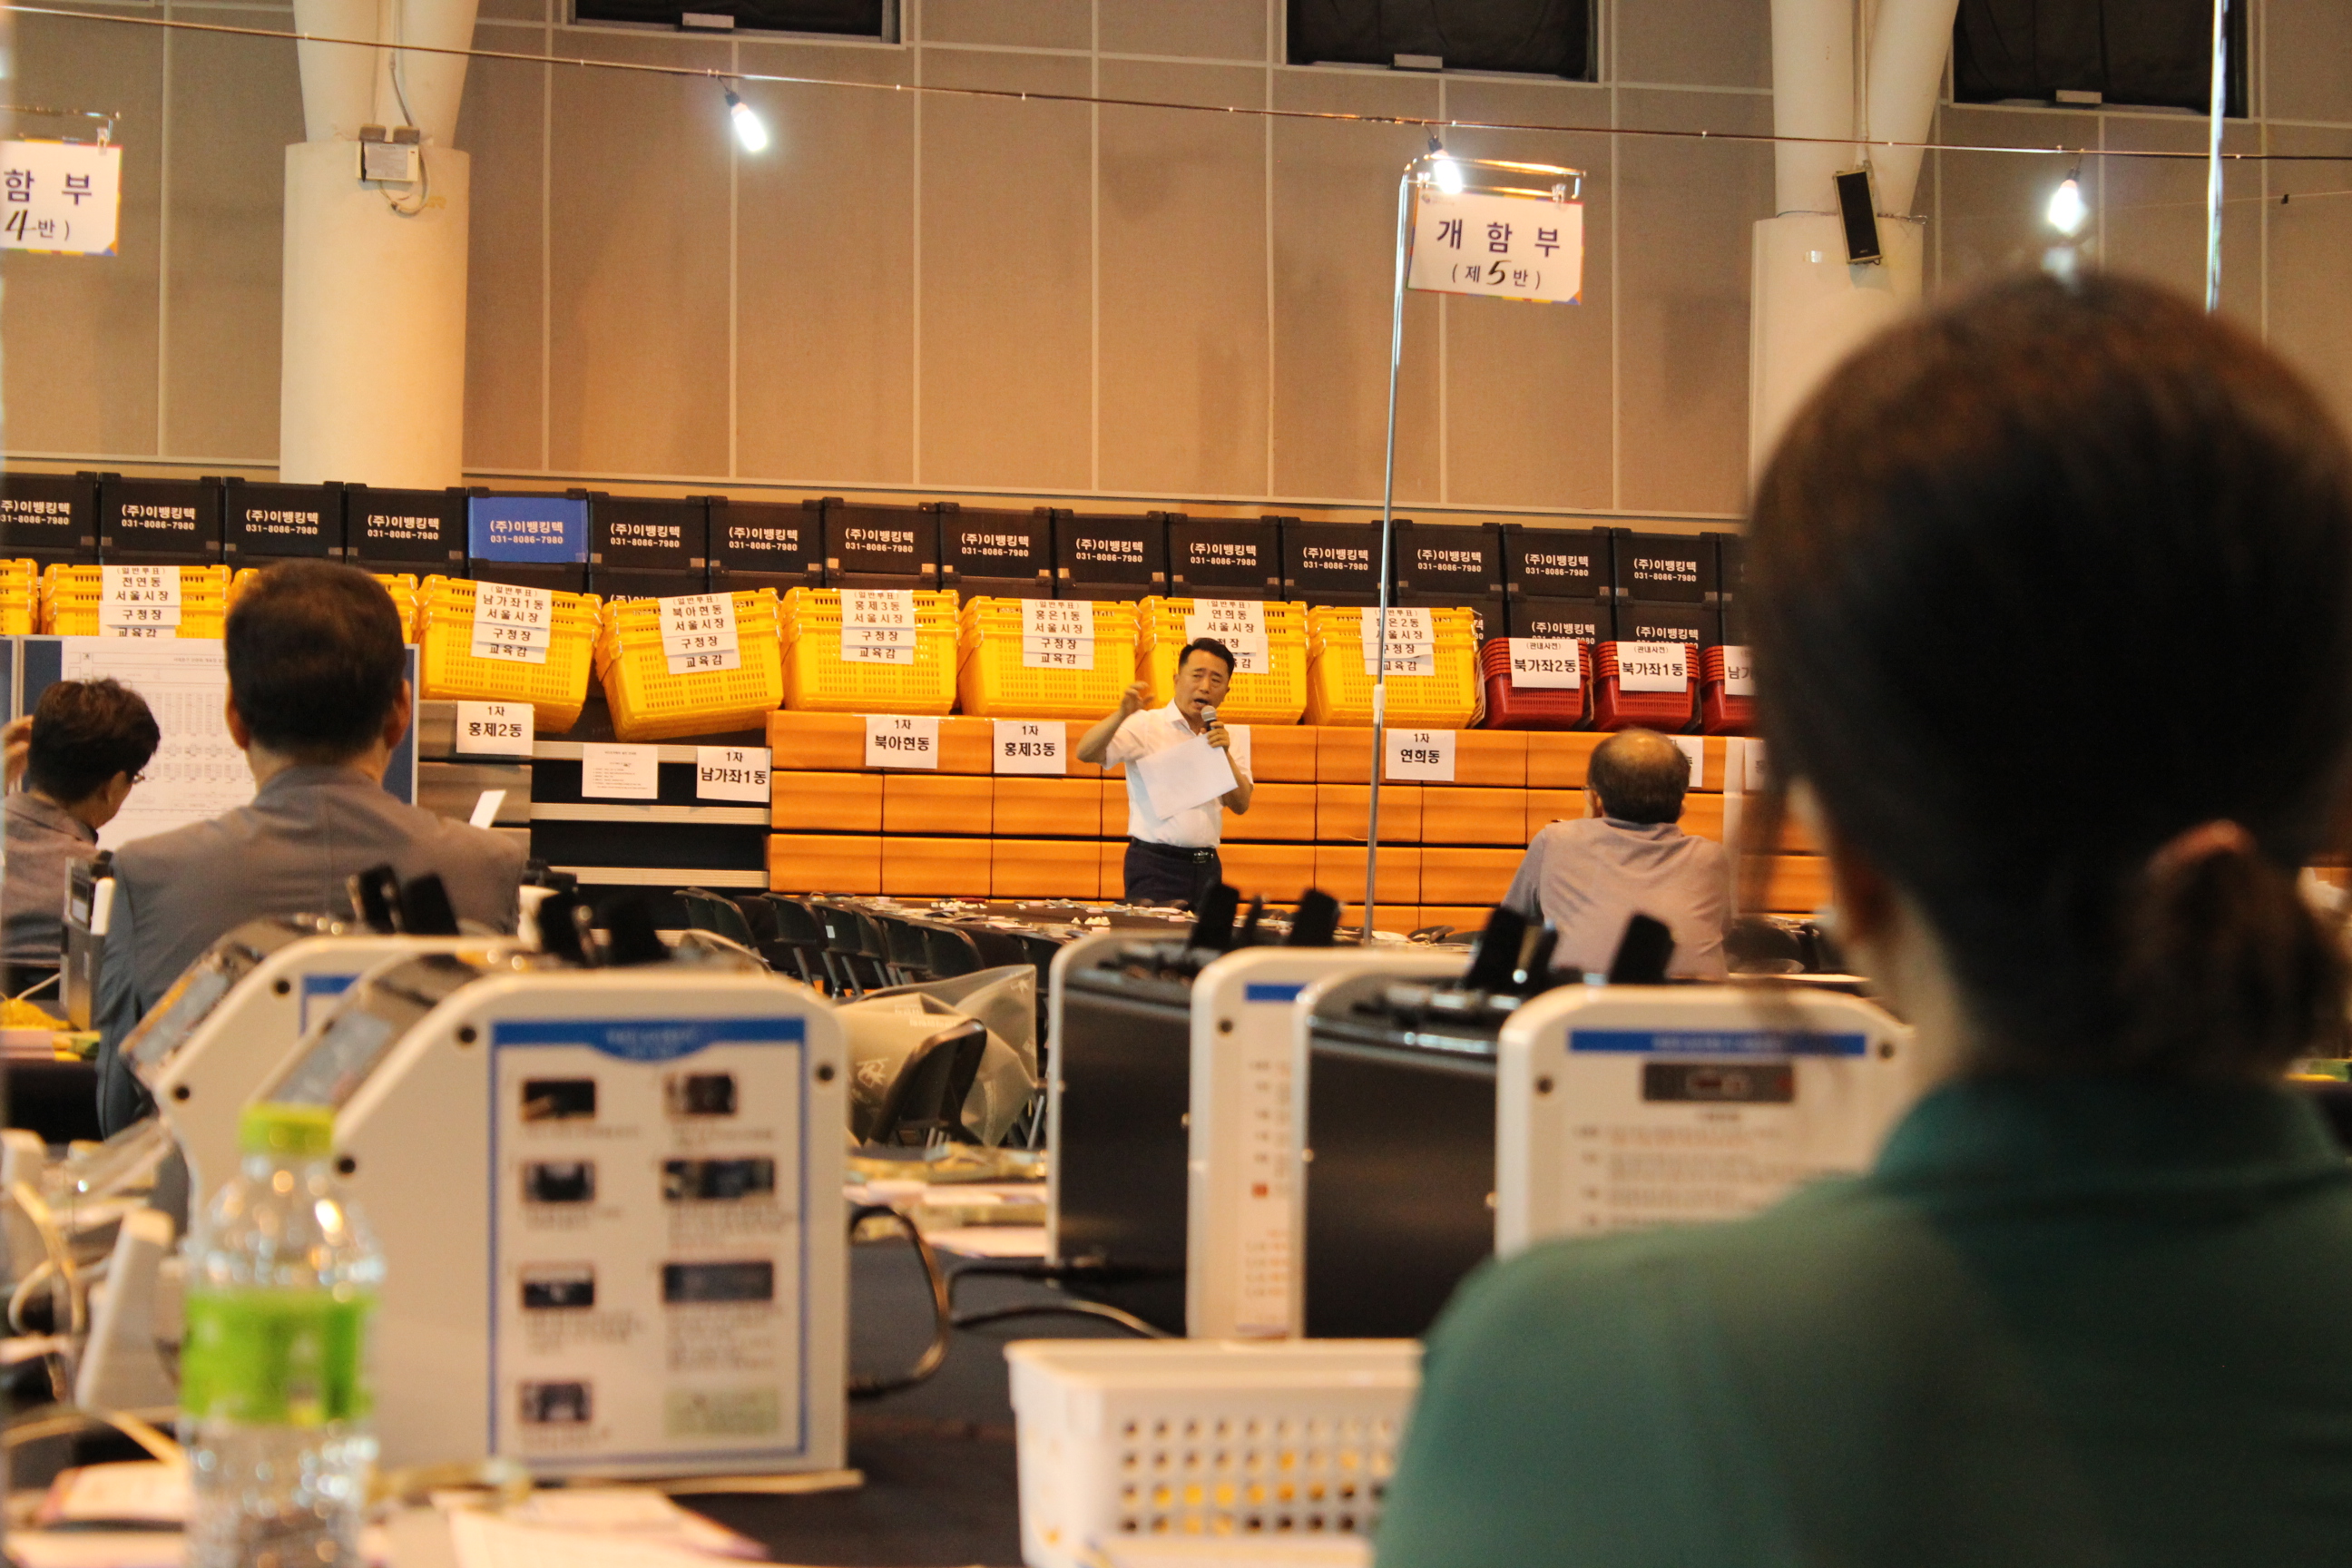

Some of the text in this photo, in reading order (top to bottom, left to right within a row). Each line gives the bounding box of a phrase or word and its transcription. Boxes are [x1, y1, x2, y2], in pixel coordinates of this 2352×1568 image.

[121, 519, 195, 530] 031-8086-7980
[245, 524, 318, 535] 031-8086-7980
[368, 530, 439, 540] 031-8086-7980
[490, 534, 564, 544] 031-8086-7980
[610, 537, 680, 547] 031-8086-7980
[729, 541, 798, 552] 031-8086-7980
[845, 542, 913, 553] 031-8086-7980
[961, 547, 1029, 557] 031-8086-7980
[1075, 553, 1142, 563] 031-8086-7980
[1190, 556, 1257, 566] 031-8086-7980
[1303, 561, 1368, 571] 031-8086-7980
[1417, 563, 1482, 573] 031-8086-7980
[1525, 567, 1589, 577] 031-8086-7980
[1634, 572, 1697, 582] 031-8086-7980
[115, 590, 169, 601] 서울시장
[483, 593, 544, 611] 남가좌1동
[486, 608, 539, 623] 서울시장
[672, 604, 722, 618] 북아현동
[854, 612, 903, 624] 서울시장
[675, 617, 725, 632] 서울시장
[1034, 622, 1083, 634] 서울시장
[1206, 622, 1255, 633] 서울시장
[489, 642, 528, 658] 교육감
[859, 646, 897, 660] 교육감
[686, 653, 723, 669] 교육감
[1040, 652, 1077, 665] 교육감
[1514, 658, 1577, 673] 북가좌2동
[1622, 662, 1684, 677] 북가좌1동
[467, 721, 523, 738] 홍제2동
[874, 735, 930, 751] 북아현동
[1004, 742, 1056, 757] 홍제3동
[1400, 749, 1441, 764] 연희동
[701, 767, 768, 785] 남가좌1동
